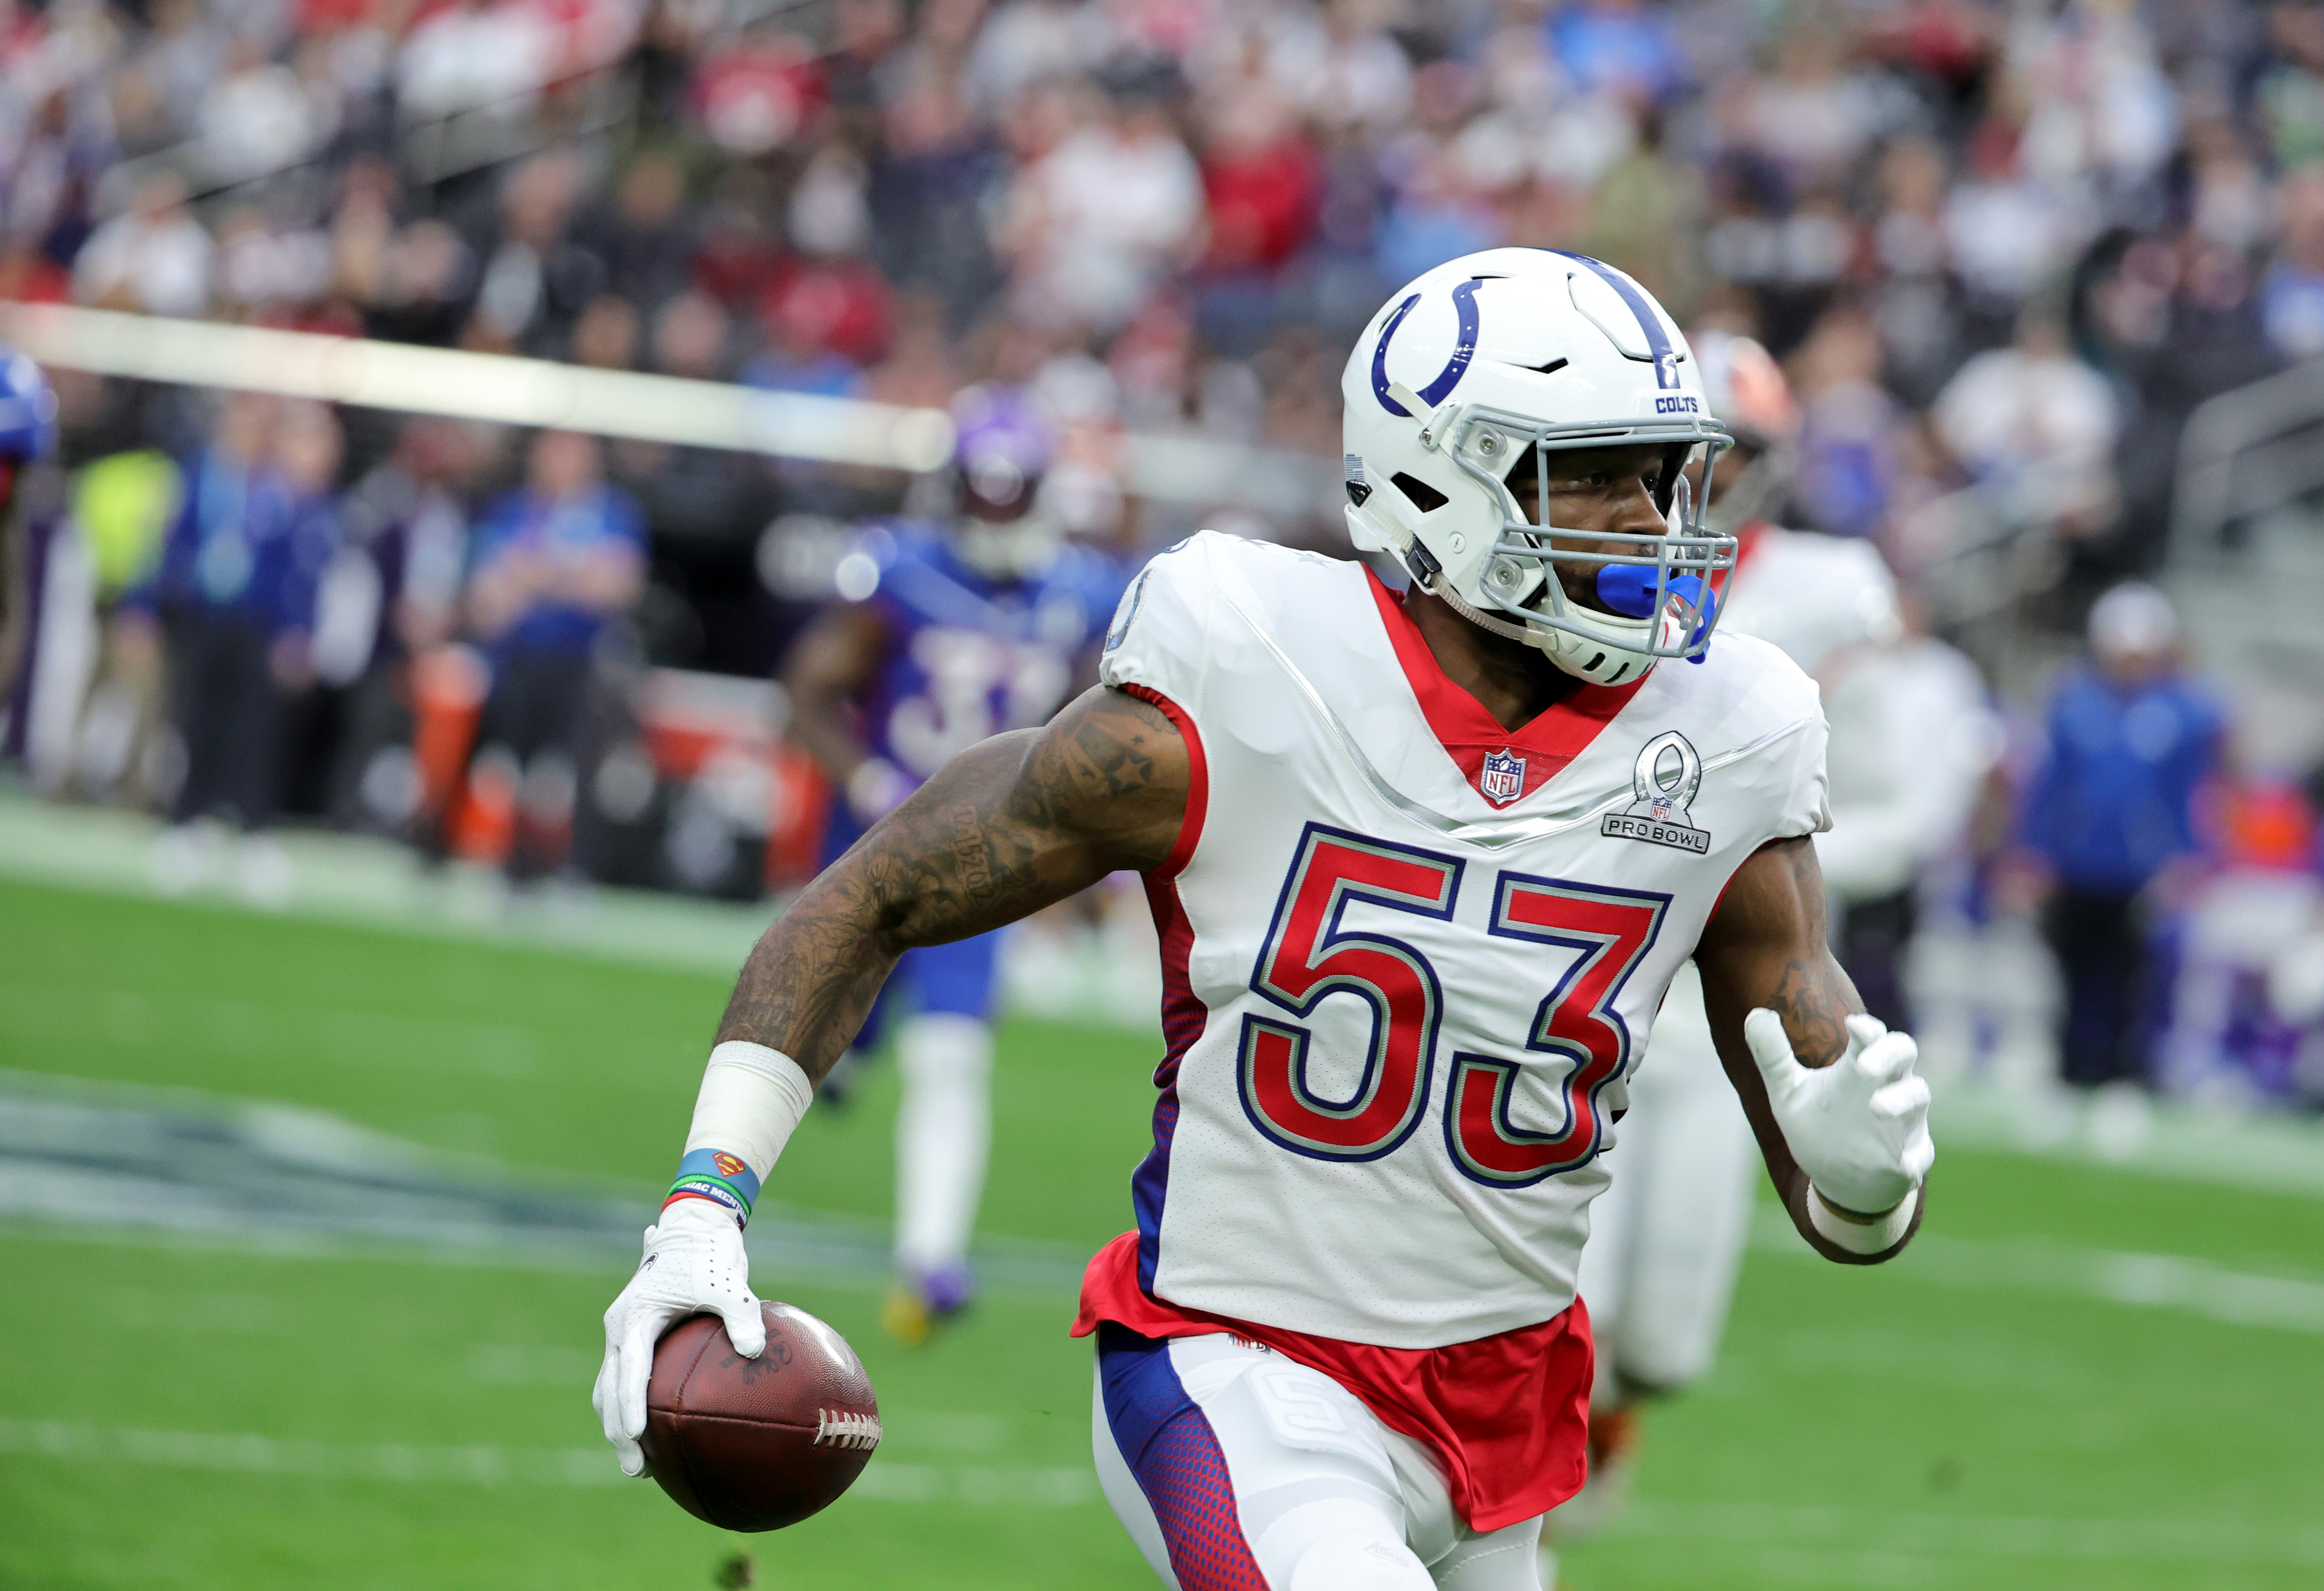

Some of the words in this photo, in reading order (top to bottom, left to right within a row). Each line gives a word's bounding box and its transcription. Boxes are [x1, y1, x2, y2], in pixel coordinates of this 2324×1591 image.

[1655, 397, 1698, 413] COLTS
[1488, 772, 1515, 794] NFL
[1653, 806, 1668, 820] NFL
[1609, 820, 1648, 836] PRO
[1653, 827, 1704, 849] BOWL
[1236, 821, 1674, 1188] 53
